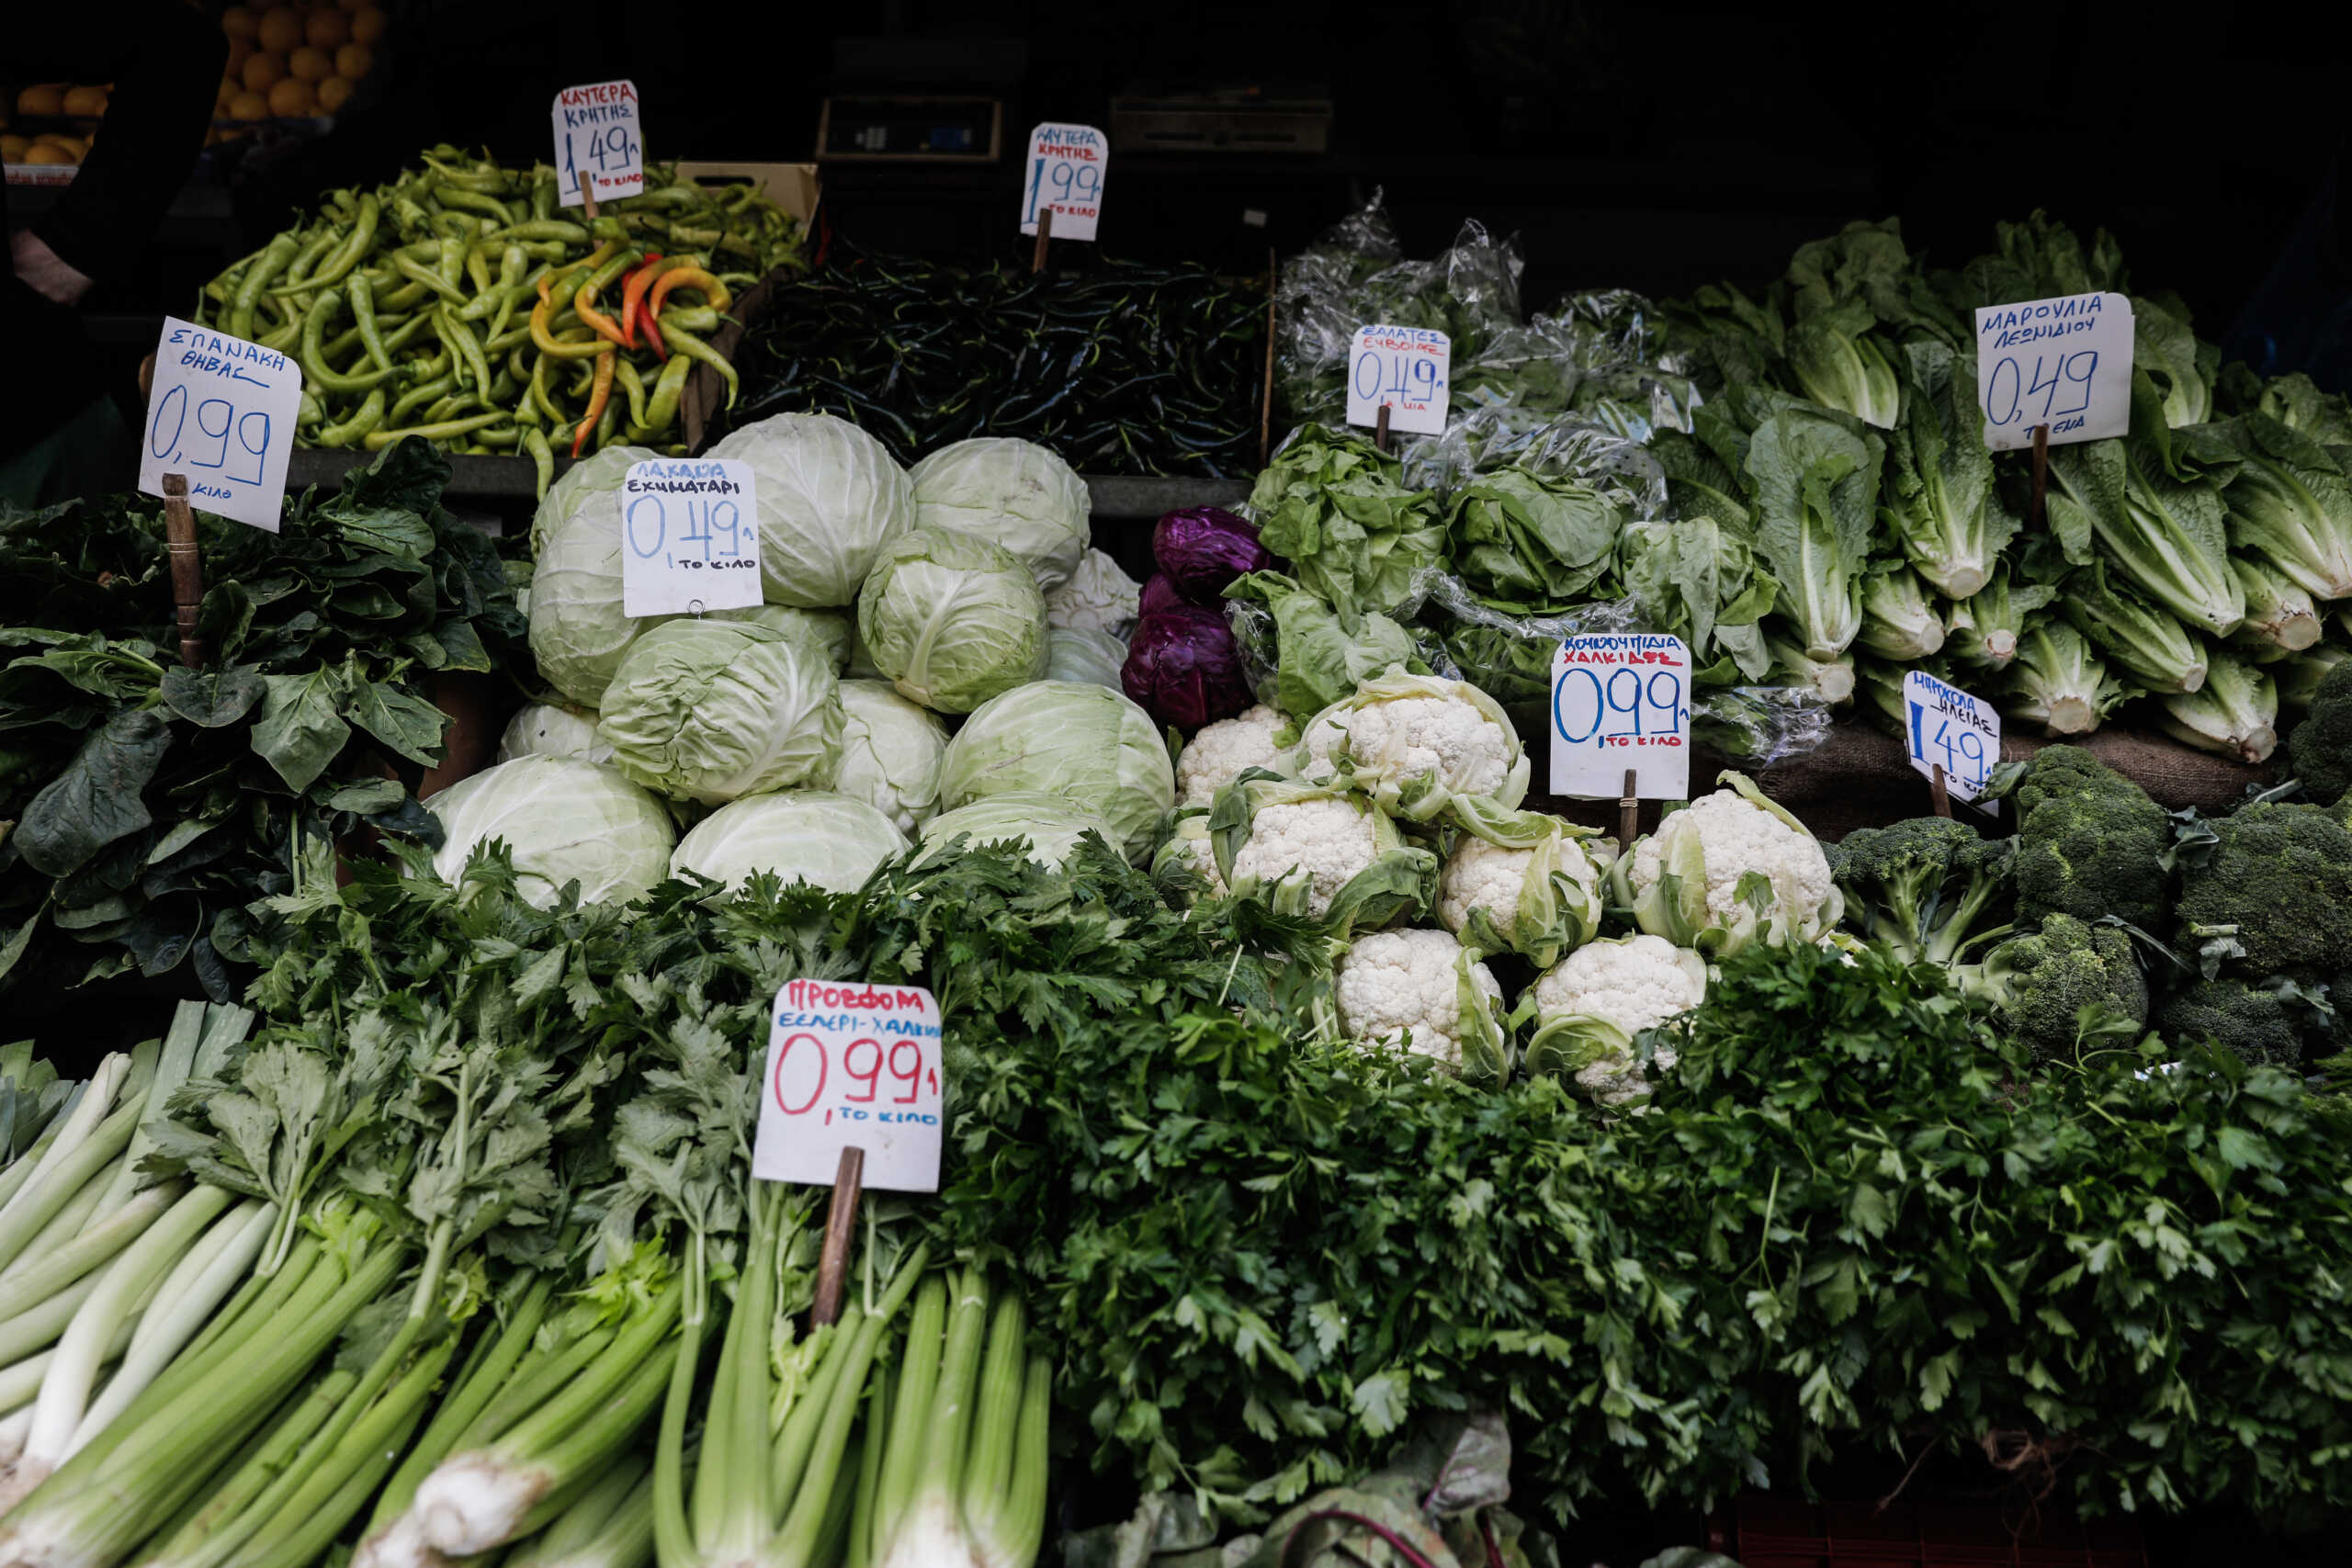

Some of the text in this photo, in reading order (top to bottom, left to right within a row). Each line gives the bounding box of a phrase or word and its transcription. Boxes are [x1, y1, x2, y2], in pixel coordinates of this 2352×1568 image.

[561, 83, 638, 107] ΚΑΥΤΕΡΑ
[564, 105, 633, 129] ΚΡΗΤΗΣ
[1038, 143, 1098, 161] ΚΡΗΤΗΣ
[615, 174, 642, 186] ΚΙΛΟ
[1982, 296, 2101, 334] ΜΑΡΟΥΛΙΑ
[1994, 317, 2095, 349] ΛΕΩΝΙΔΙΟΥ
[169, 329, 285, 371] ΣΠΑΝΑΚΗ
[1987, 351, 2098, 426] 0,49
[152, 384, 271, 486] 0,99
[2052, 415, 2085, 434] ΕΝΑ
[191, 482, 232, 499] ΚΙΛΟ
[679, 559, 756, 569] ΤΟ ΚΙΛΟ
[1606, 737, 1681, 747] ΤΟ ΚΙΛΟ
[840, 1107, 938, 1125] ΤΟ ΚΙΛΟ
